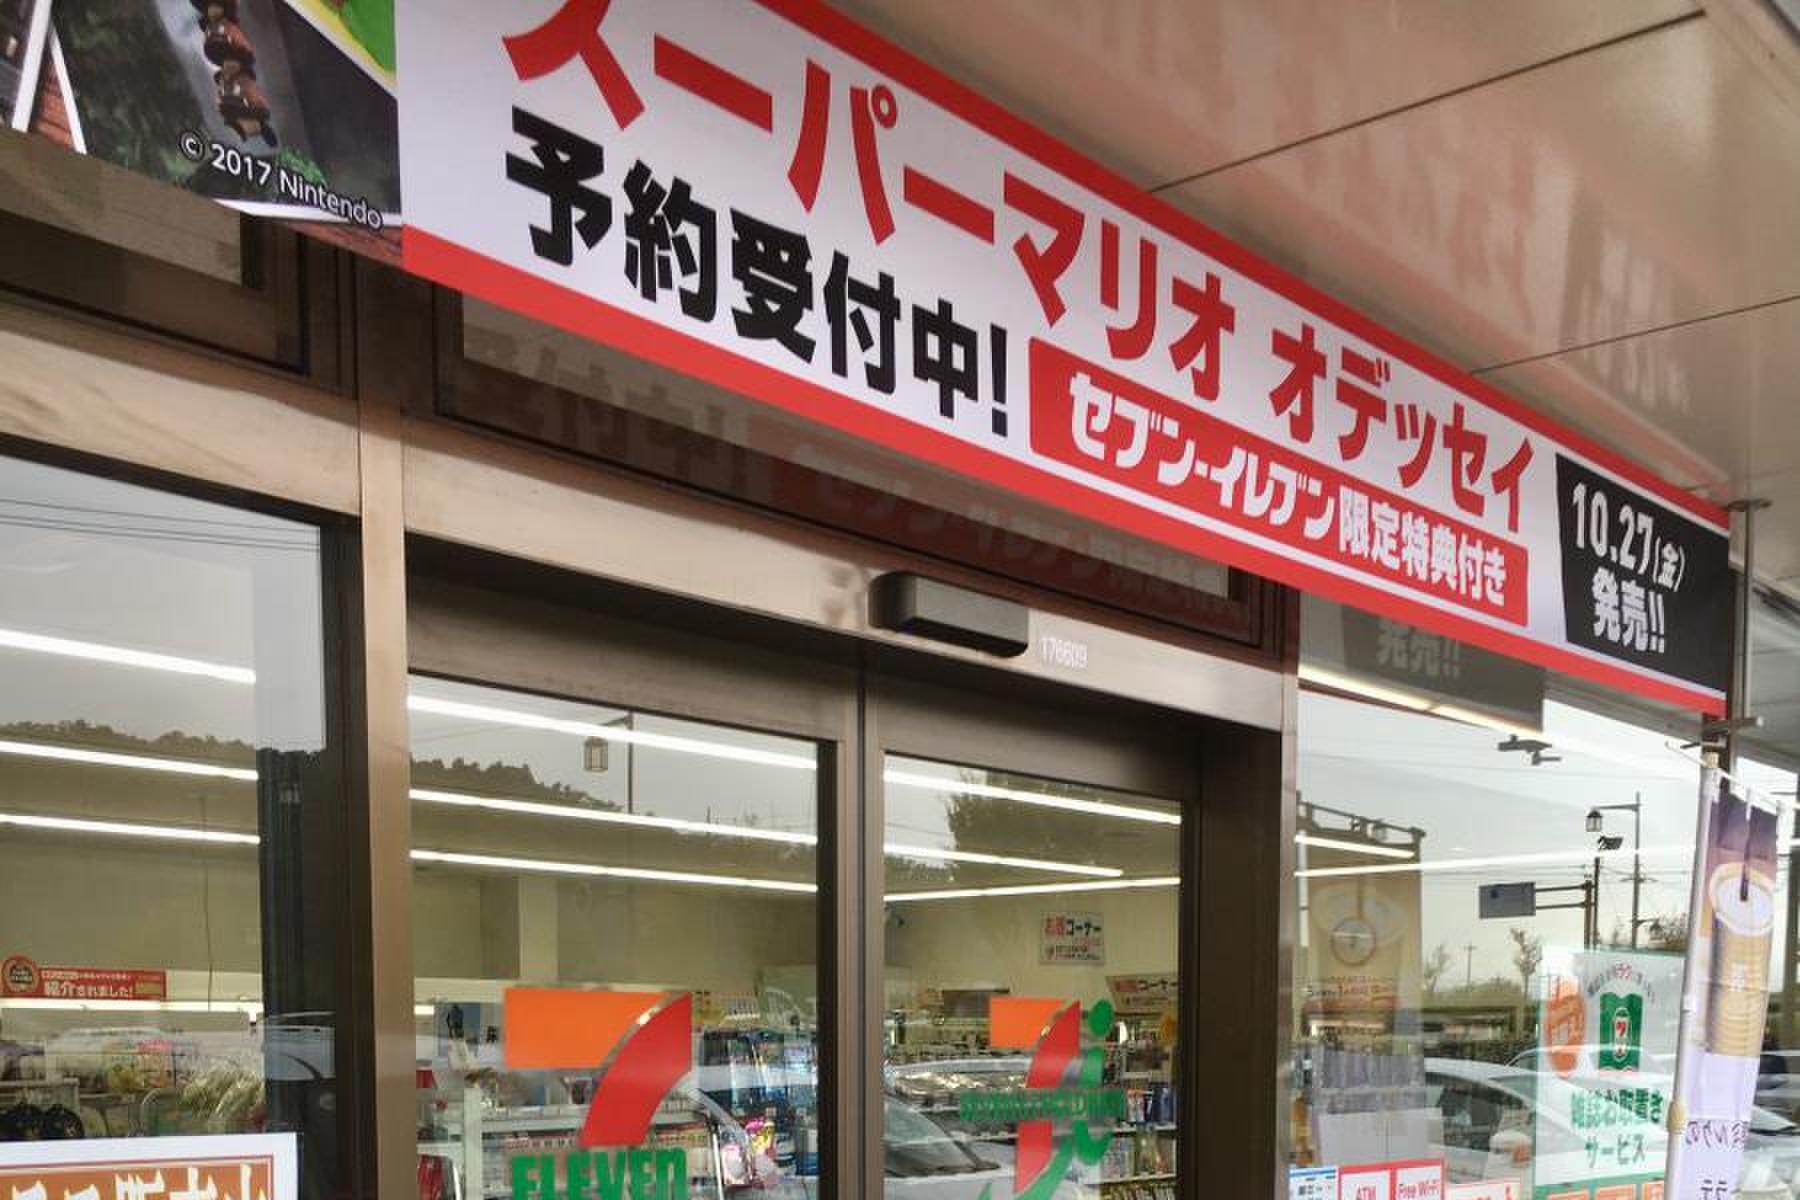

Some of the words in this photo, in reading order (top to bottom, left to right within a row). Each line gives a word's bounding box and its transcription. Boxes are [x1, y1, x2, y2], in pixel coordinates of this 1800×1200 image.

[211, 143, 271, 186] 2017
[279, 169, 384, 229] Nintendo
[505, 104, 1008, 437] 予約受付中!
[1070, 371, 1507, 607] セブン-イレブン限定特典付き
[1269, 322, 1534, 533] オデッセイ
[1591, 565, 1666, 653] 発売!!
[1585, 1133, 1646, 1168] サービス
